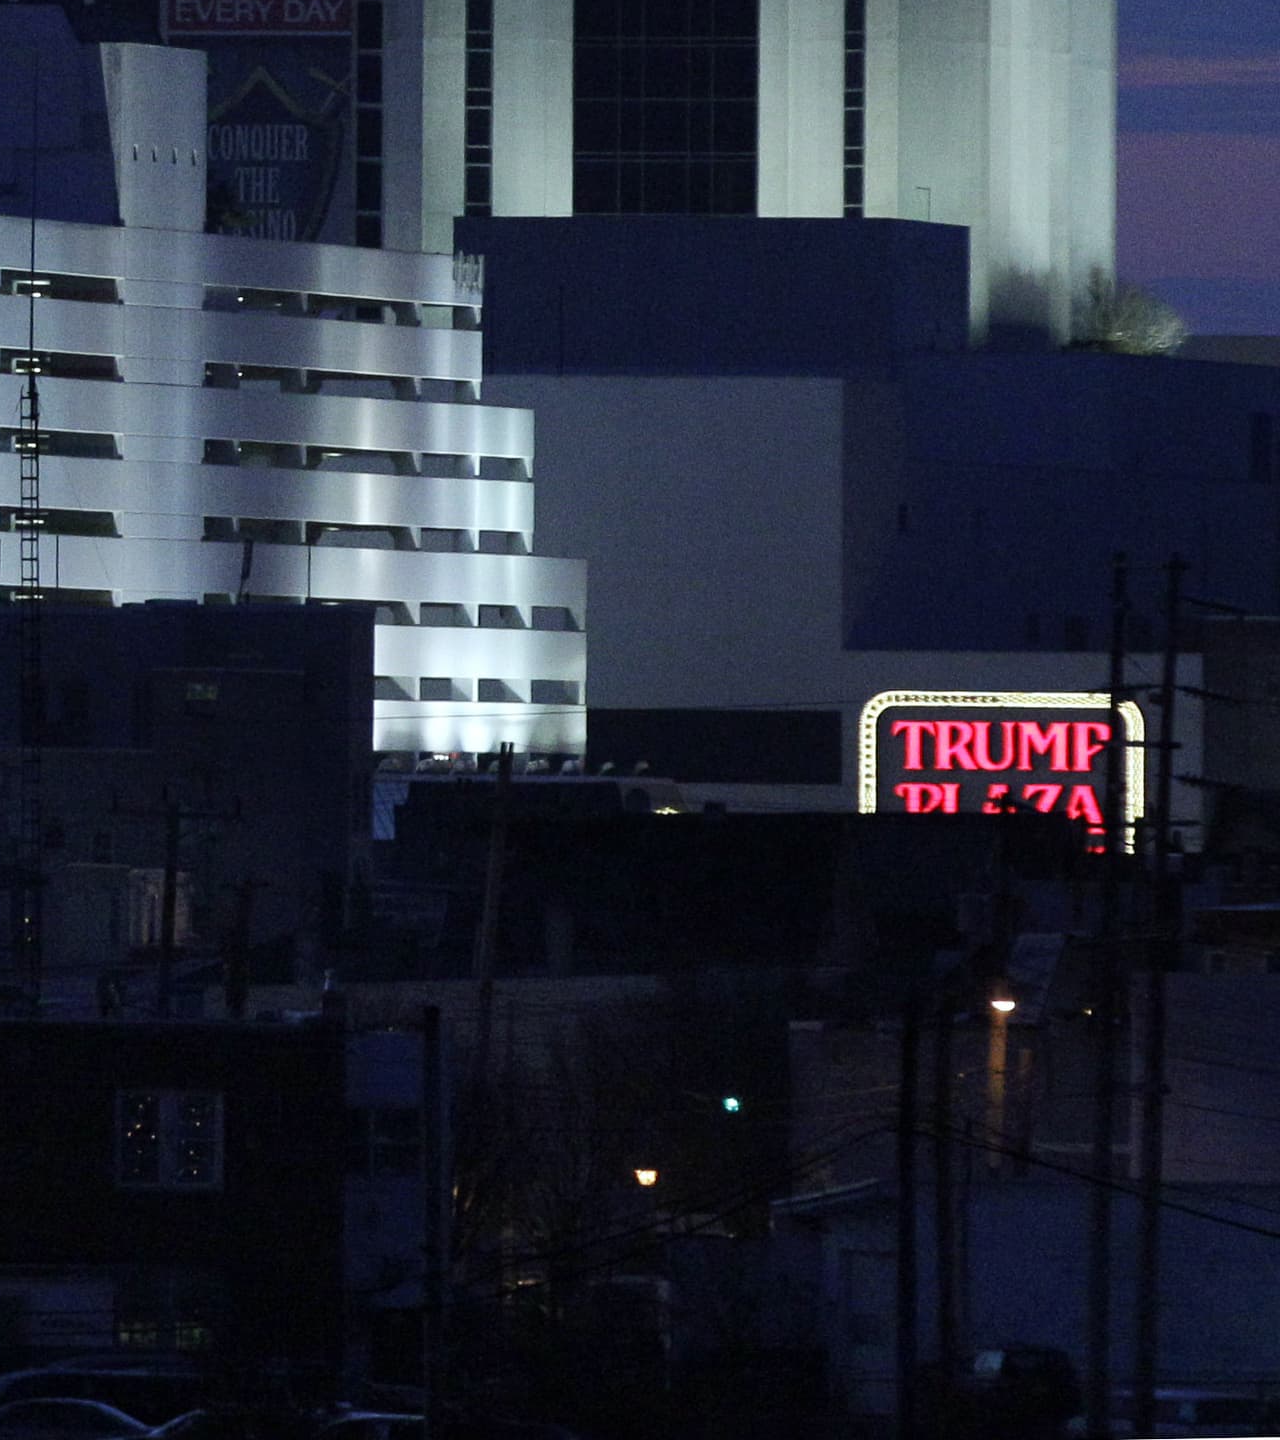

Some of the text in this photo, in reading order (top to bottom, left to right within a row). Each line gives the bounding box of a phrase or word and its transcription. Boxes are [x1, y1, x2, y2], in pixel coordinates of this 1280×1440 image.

[284, 0, 344, 23] DAY
[207, 123, 308, 160] CONQUER
[236, 166, 280, 203] THE
[892, 720, 1112, 772] TRUMP
